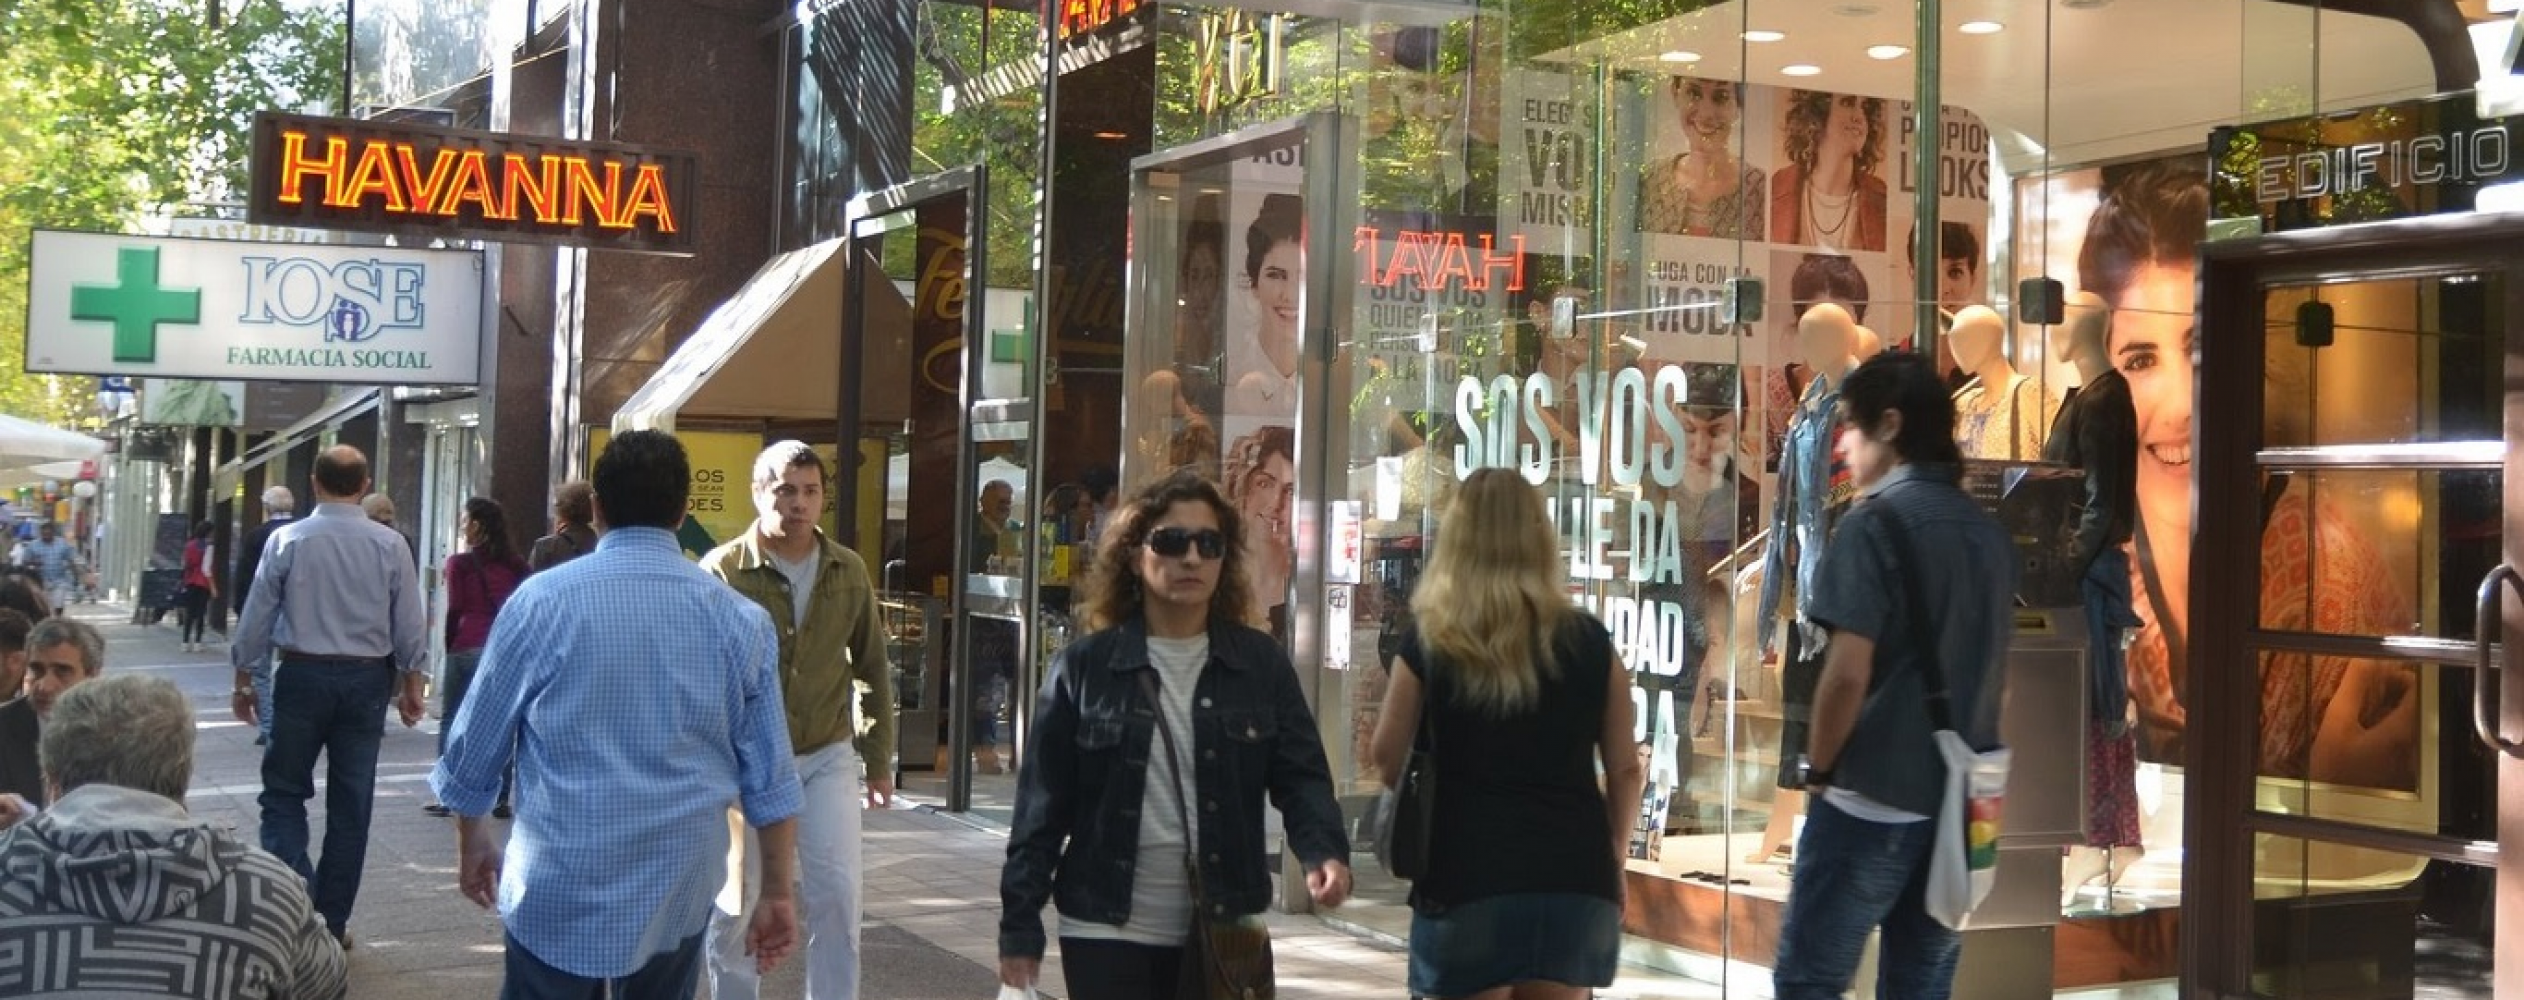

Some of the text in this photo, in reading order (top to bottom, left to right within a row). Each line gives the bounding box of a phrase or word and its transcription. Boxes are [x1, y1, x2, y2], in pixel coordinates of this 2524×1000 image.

[278, 130, 677, 234] HAVANNA
[1525, 128, 1617, 192] VO
[2257, 126, 2509, 203] EDIFICIO
[238, 256, 425, 342] IOSE
[227, 346, 432, 370] FARMACIA SOCIAL
[1454, 364, 1688, 487] SOS VOS
[1628, 500, 1684, 585] DA
